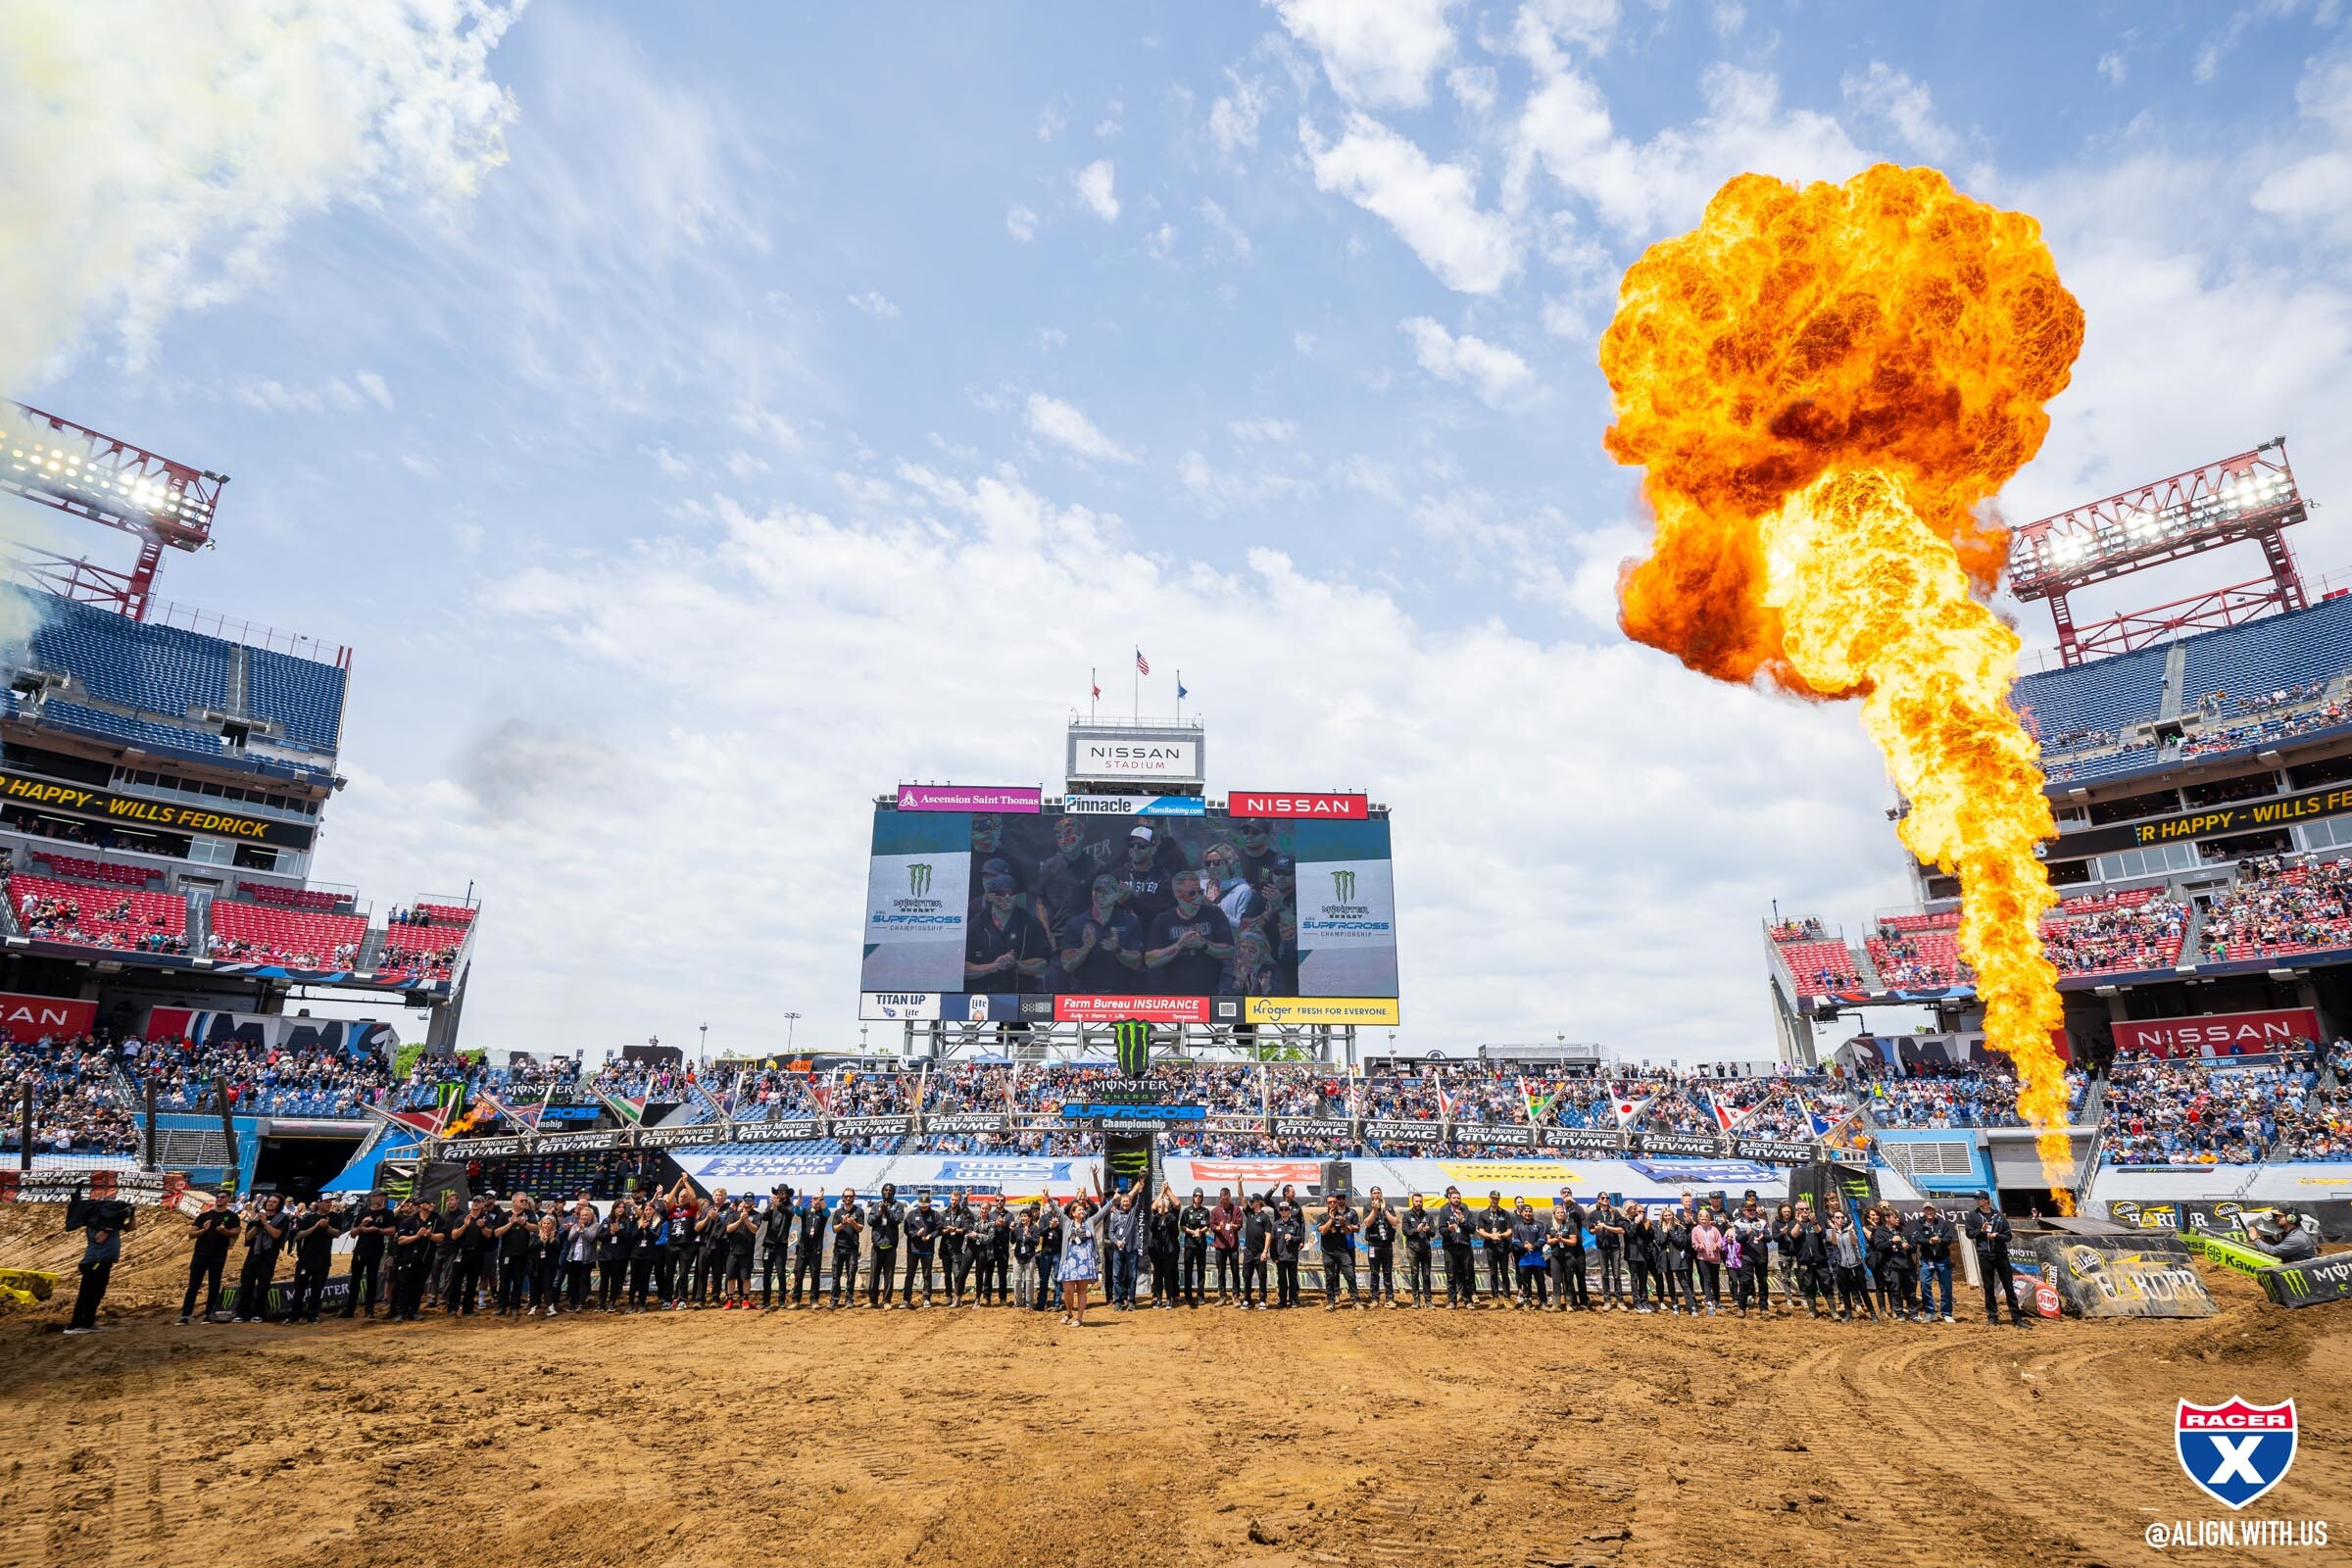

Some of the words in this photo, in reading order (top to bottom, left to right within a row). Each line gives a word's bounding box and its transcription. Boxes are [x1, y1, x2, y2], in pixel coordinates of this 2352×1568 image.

[1091, 747, 1180, 759] NISSAN
[1105, 760, 1165, 769] STADIUM
[920, 795, 970, 805] Ascension
[973, 795, 998, 805] Saint
[999, 796, 1039, 806] Thomas
[1066, 796, 1132, 812] Pinnacle
[1248, 799, 1349, 813] NISSAN
[8, 779, 94, 808] HAPPY
[109, 799, 174, 822] WILLS
[176, 809, 270, 838] FEDRICK
[1147, 807, 1203, 816] TitansBanking.com
[2162, 811, 2234, 838] HAPPY
[2253, 797, 2321, 823] WILLS
[871, 915, 962, 924] SUPERCROSS
[1302, 921, 1390, 930] SUPERCROSS
[875, 995, 908, 1004] TITAN
[909, 995, 926, 1004] UP
[1063, 998, 1091, 1008] Farm
[1094, 1000, 1130, 1008] Bureau
[1133, 1000, 1200, 1009] INSURANCE
[905, 1008, 919, 1017] Lite
[1253, 999, 1292, 1021] Kroger
[2137, 1022, 2290, 1046] NISSAN
[1093, 1079, 1169, 1092] MONSTER
[1062, 1104, 1206, 1119] SUPERCROSS
[1102, 1118, 1166, 1130] Championship
[573, 1133, 612, 1142] MOUNTAIN
[1653, 1134, 1677, 1143] ROCKY
[1677, 1136, 1714, 1145] MOUNTAIN
[479, 1139, 519, 1148] MOUNTAIN
[1774, 1143, 1811, 1152] MOUNTAIN
